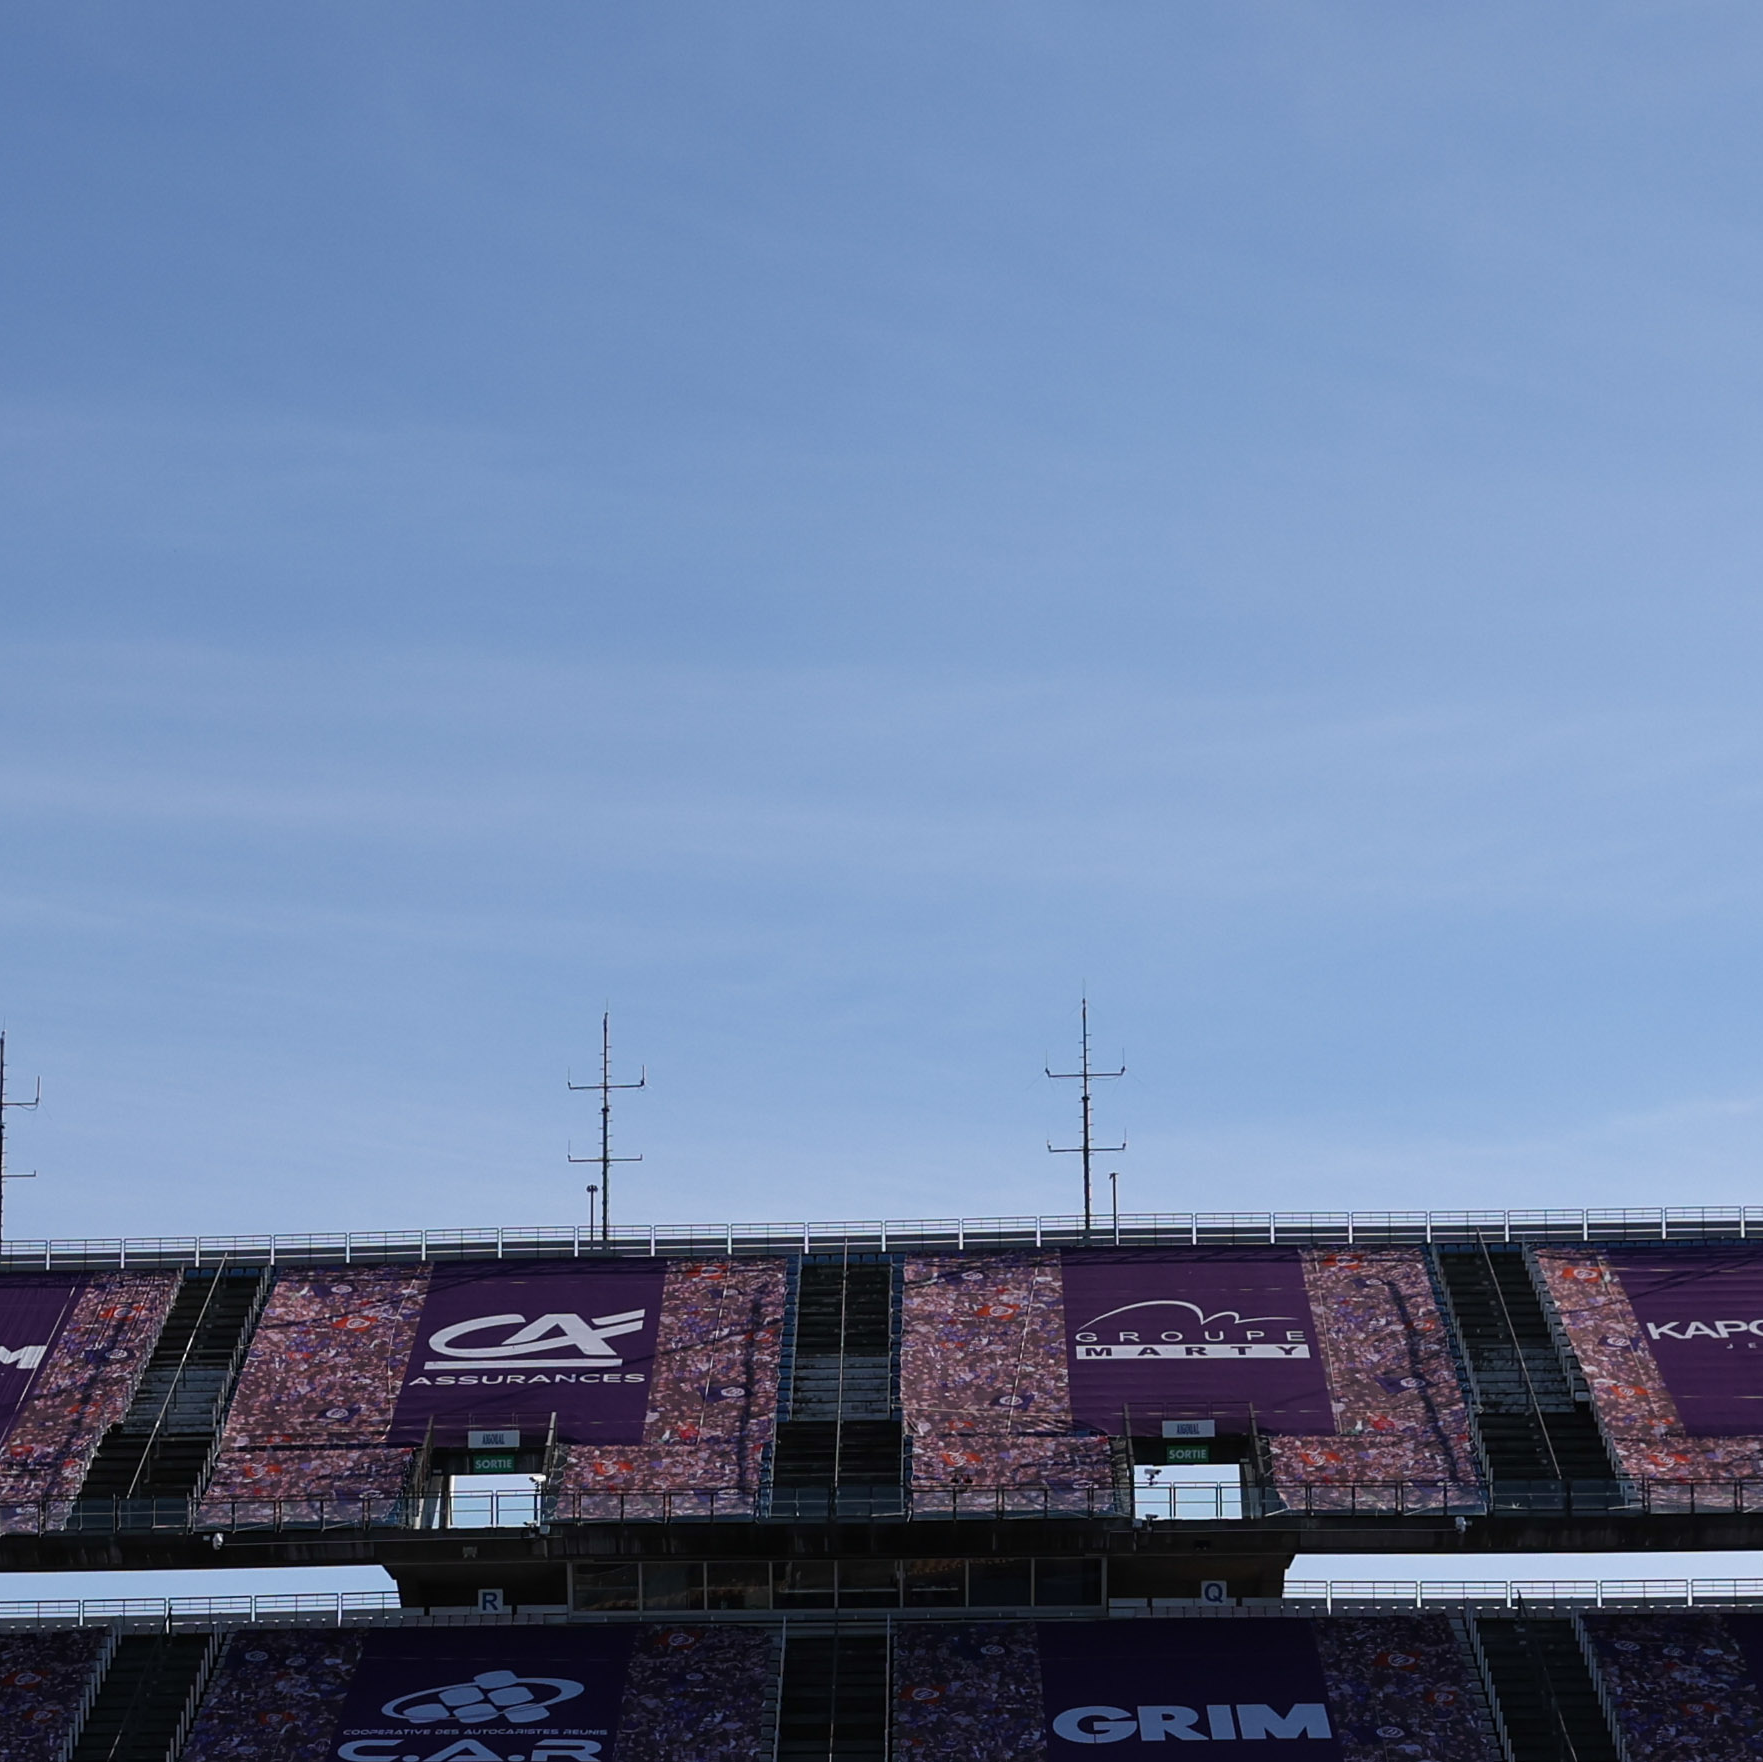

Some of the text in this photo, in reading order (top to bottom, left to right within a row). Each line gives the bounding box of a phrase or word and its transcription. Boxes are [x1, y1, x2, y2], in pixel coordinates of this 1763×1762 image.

[1075, 1331, 1307, 1342] GROUPE
[1085, 1347, 1300, 1357] MARTY
[408, 1373, 646, 1386] ASSURANCES
[1169, 1449, 1207, 1460] SORTIE
[475, 1459, 513, 1470] SORTIE
[1204, 1582, 1223, 1604] Q
[482, 1591, 498, 1611] R
[1052, 1703, 1333, 1743] GRIM
[342, 1727, 608, 1737] COOPERATIVE DES AUTOCARISTES REUNIS
[337, 1738, 603, 1762] C.A.R
